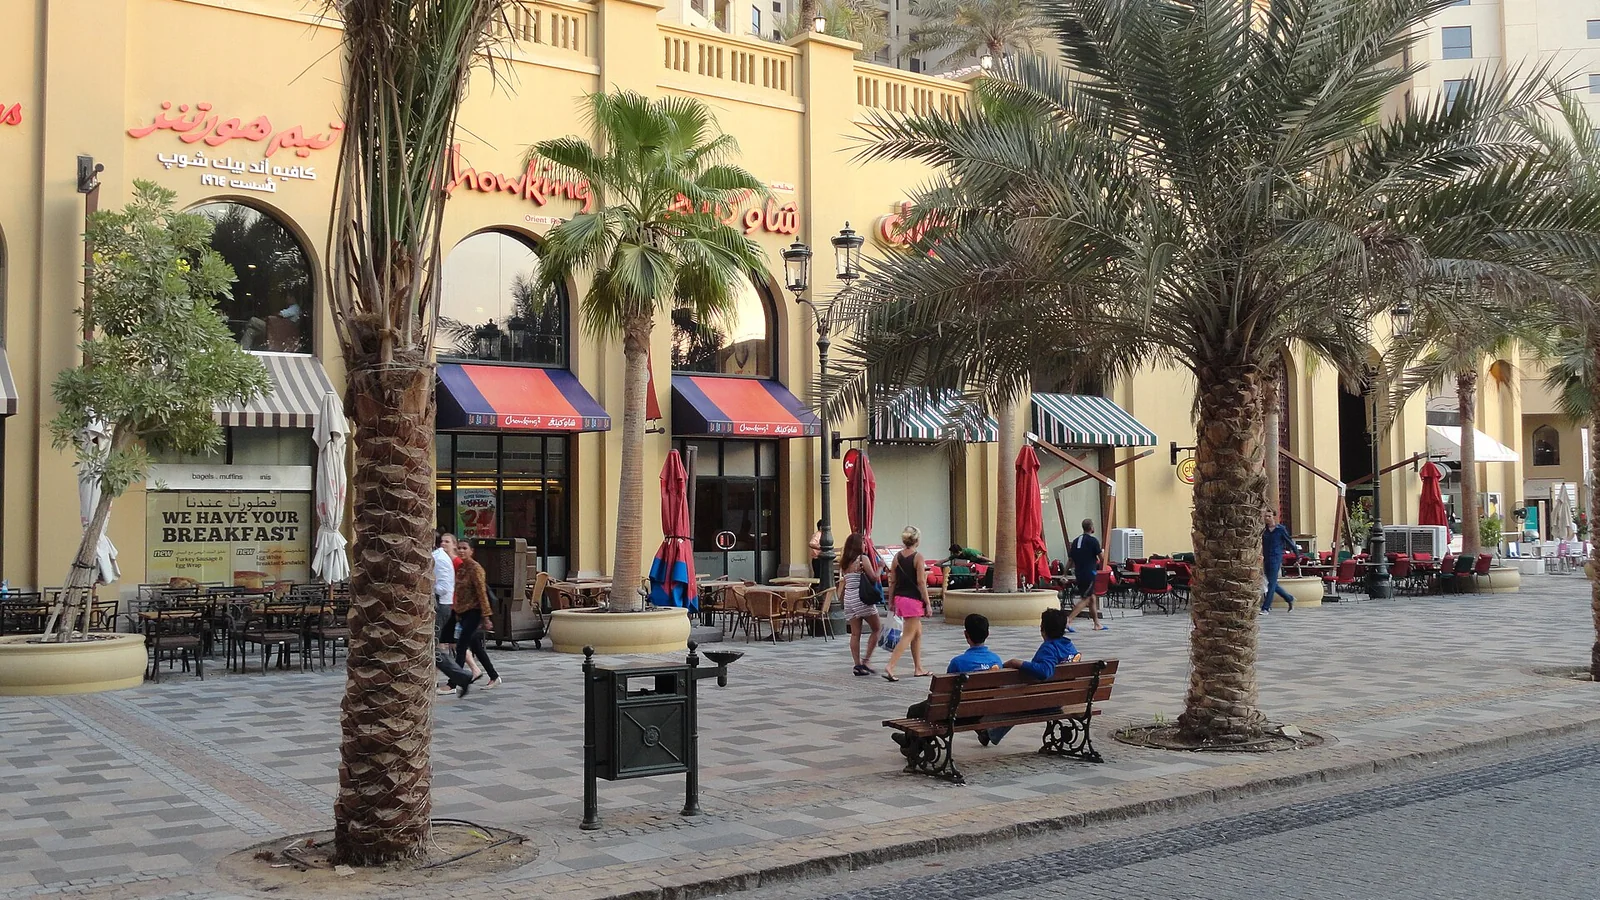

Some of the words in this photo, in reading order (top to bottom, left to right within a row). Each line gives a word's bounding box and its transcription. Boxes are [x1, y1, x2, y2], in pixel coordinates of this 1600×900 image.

[248, 158, 269, 175] أند
[272, 165, 317, 181] كافيه
[430, 143, 593, 214] howking
[525, 215, 547, 224] Orient
[192, 473, 214, 481] bagels
[186, 496, 223, 508] عندنا
[228, 496, 277, 511] فطورك
[162, 511, 192, 524] WE
[196, 511, 248, 524] HAVE
[250, 511, 299, 524] YOUR
[162, 526, 299, 543] BREAKFAST
[153, 549, 174, 558] new
[236, 548, 255, 556] new
